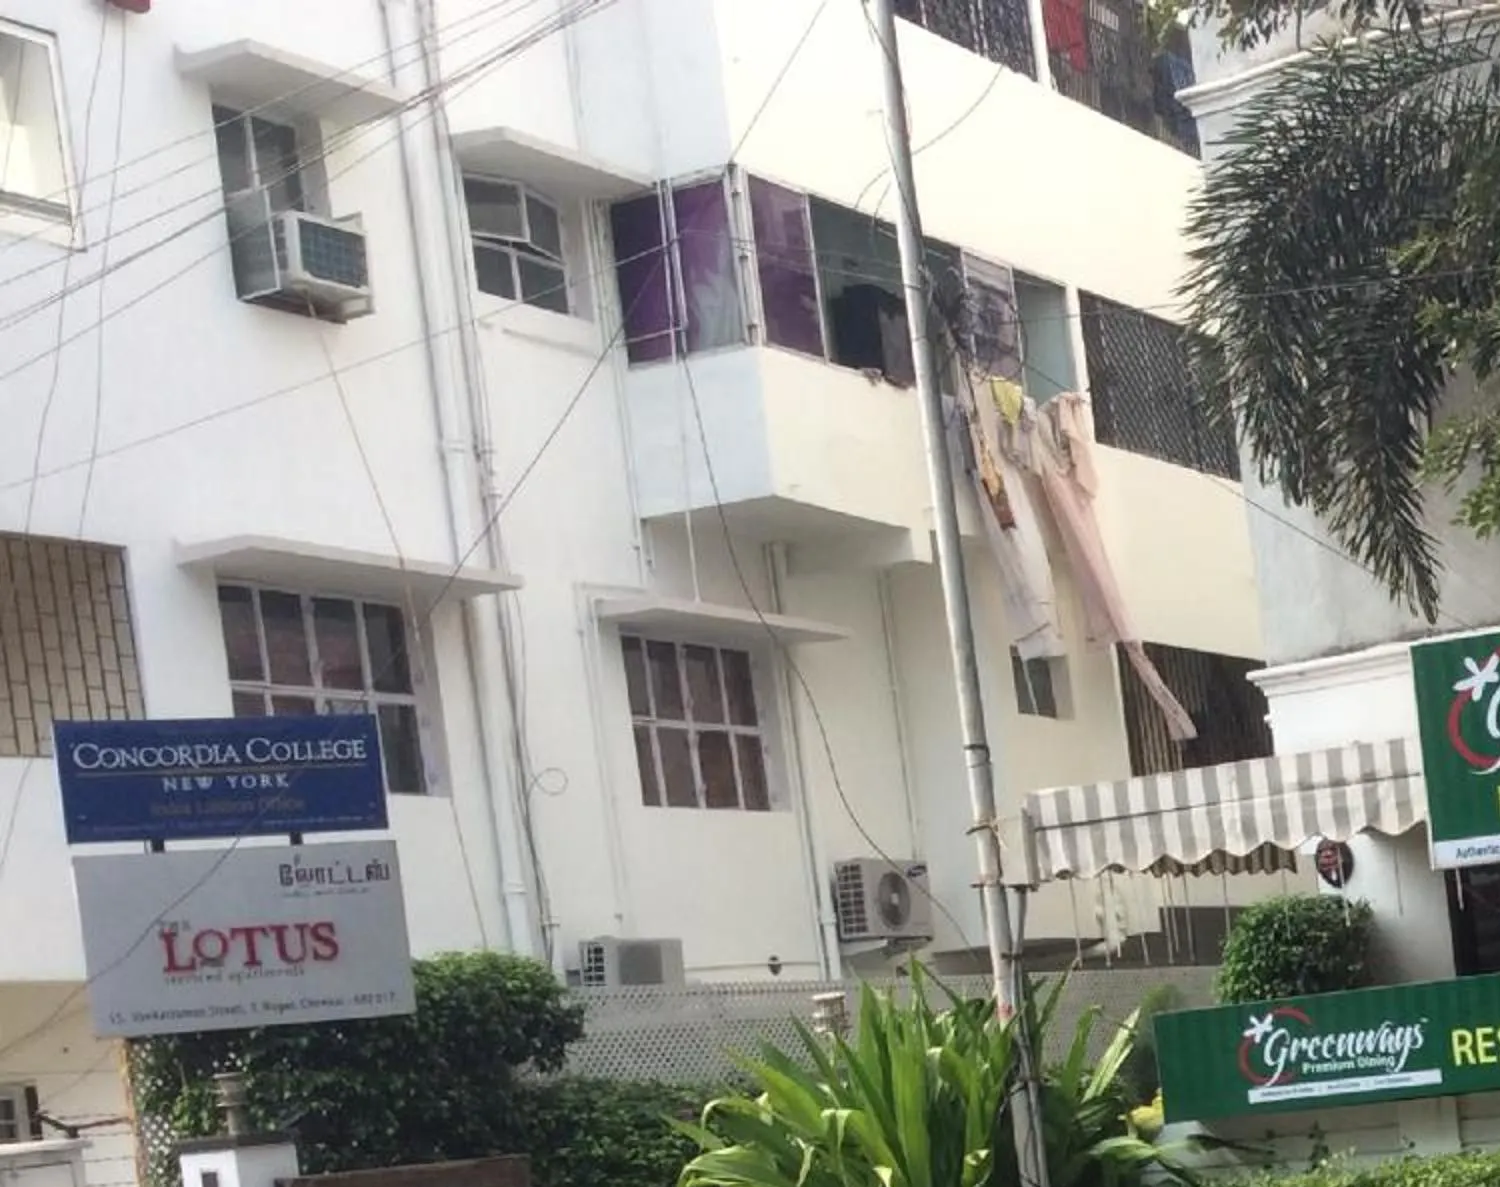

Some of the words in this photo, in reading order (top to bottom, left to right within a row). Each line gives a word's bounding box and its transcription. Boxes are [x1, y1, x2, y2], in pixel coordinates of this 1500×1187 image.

[72, 742, 242, 771] CONCORDIA
[246, 738, 367, 764] COLLEGE
[163, 776, 214, 792] NEW
[228, 772, 290, 789] YORK
[161, 922, 339, 972] LOTUS
[1263, 1021, 1424, 1087] Greenways
[1302, 1060, 1355, 1074] Premium
[1357, 1055, 1395, 1070] Dining
